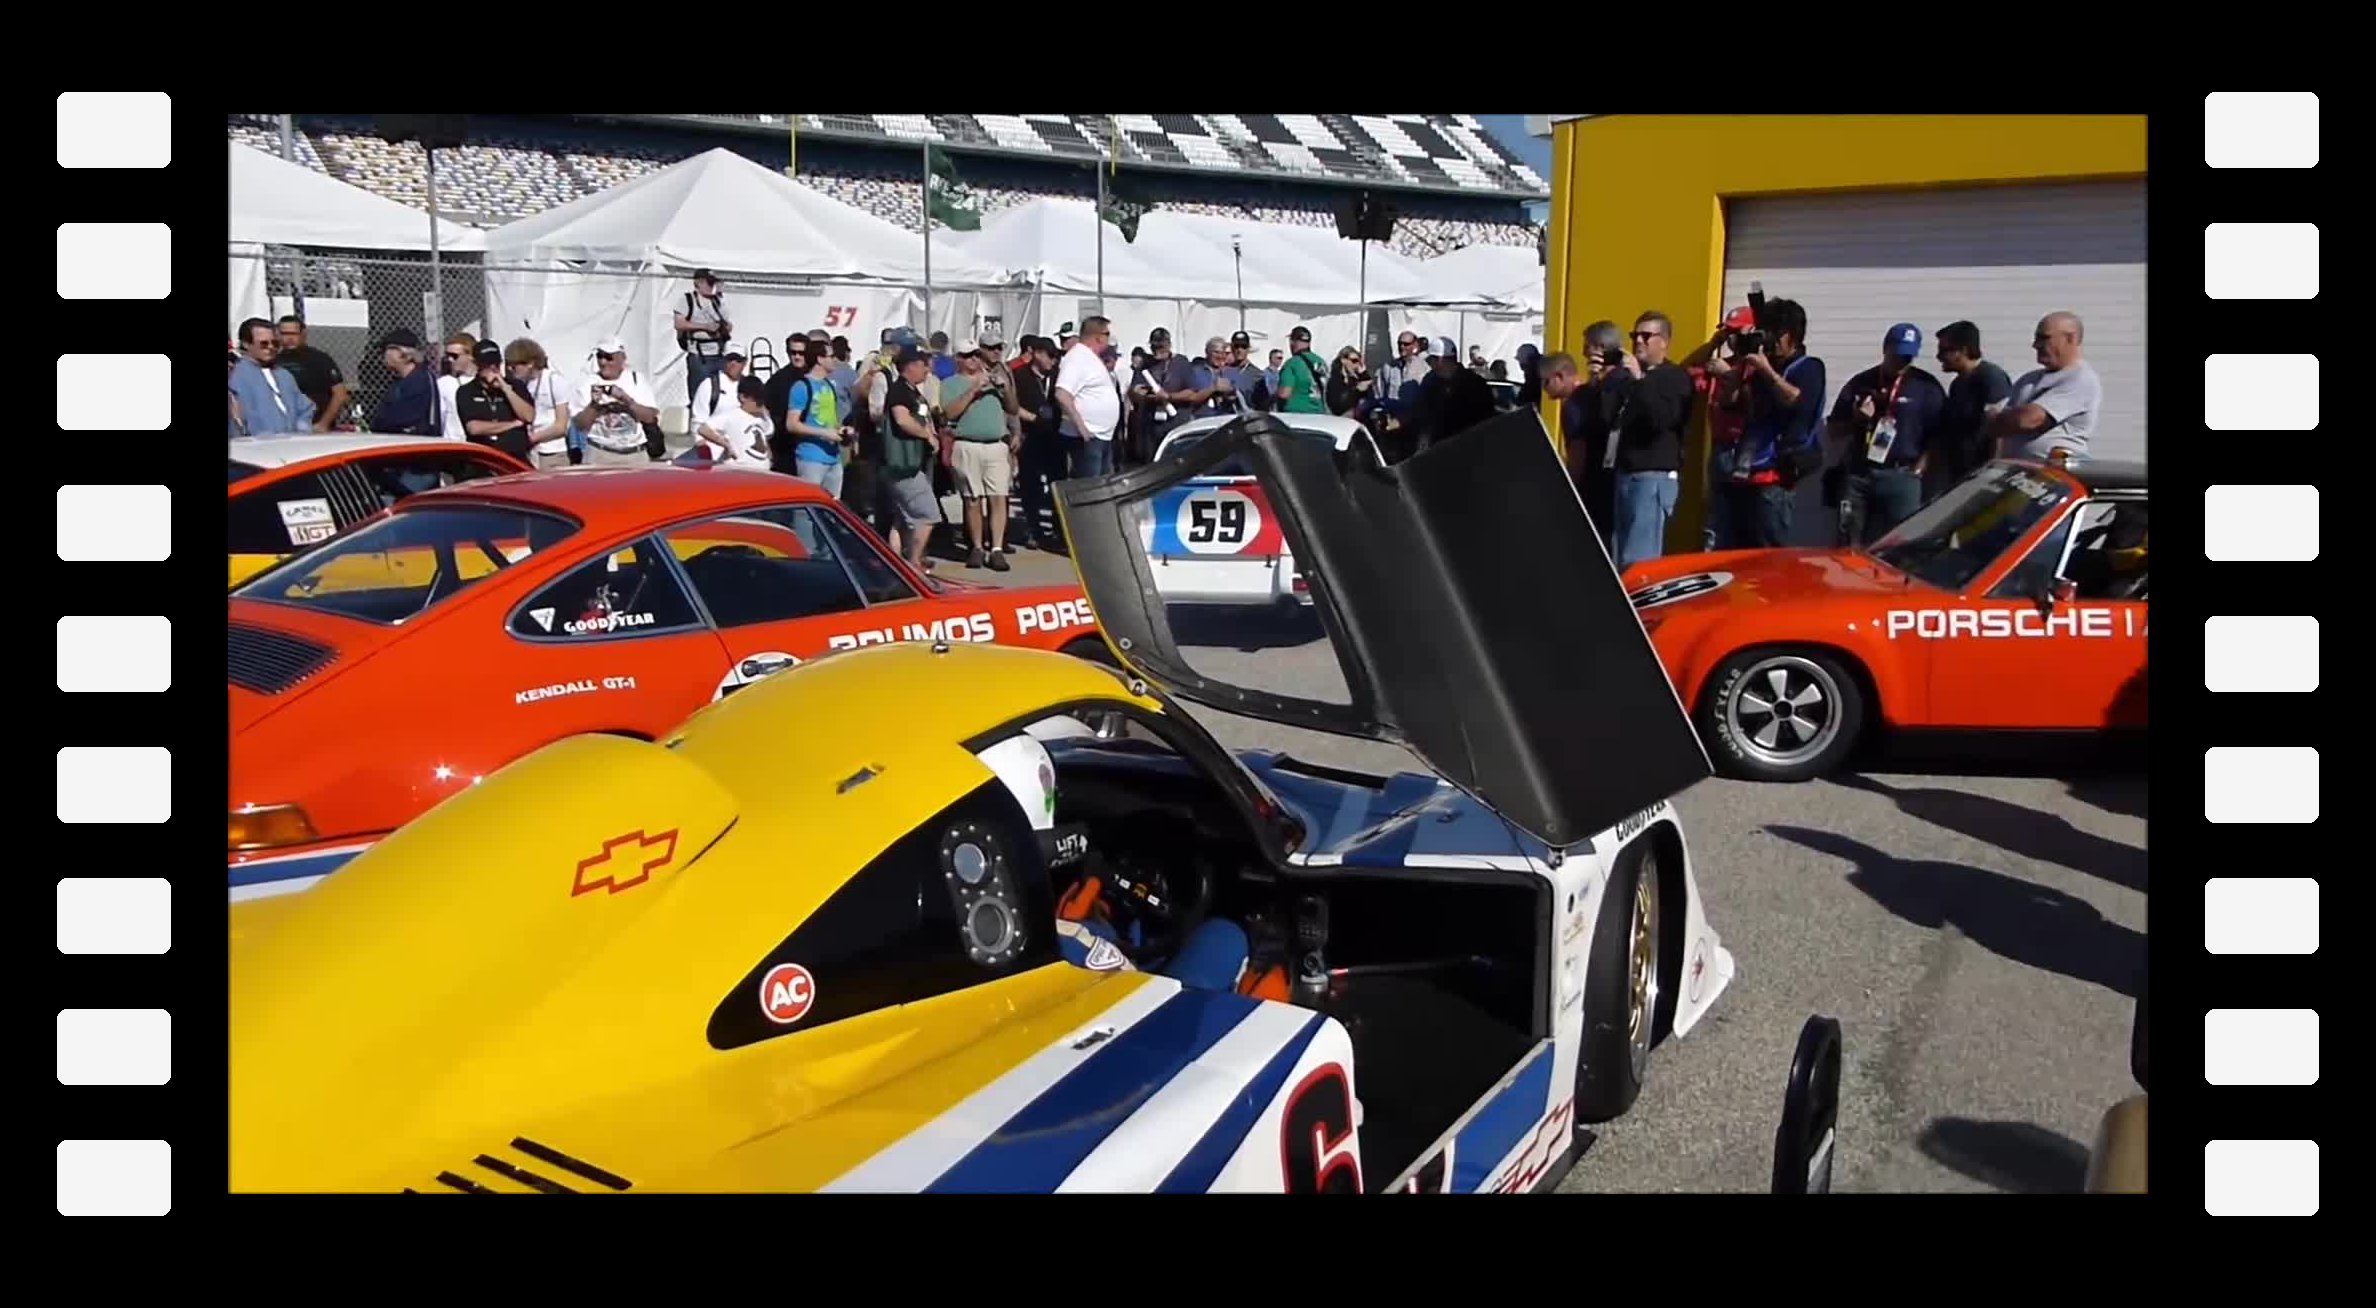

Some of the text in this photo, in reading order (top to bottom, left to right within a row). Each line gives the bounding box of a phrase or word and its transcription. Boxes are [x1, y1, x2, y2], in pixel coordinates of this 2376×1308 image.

[824, 306, 858, 328] 57
[1188, 500, 1246, 543] 59
[563, 611, 655, 632] GOODYEAR
[1887, 607, 2112, 639] PORSCHE
[515, 676, 636, 705] KENDALL GT-1
[1056, 834, 1078, 852] LIFT
[769, 972, 810, 1013] AC
